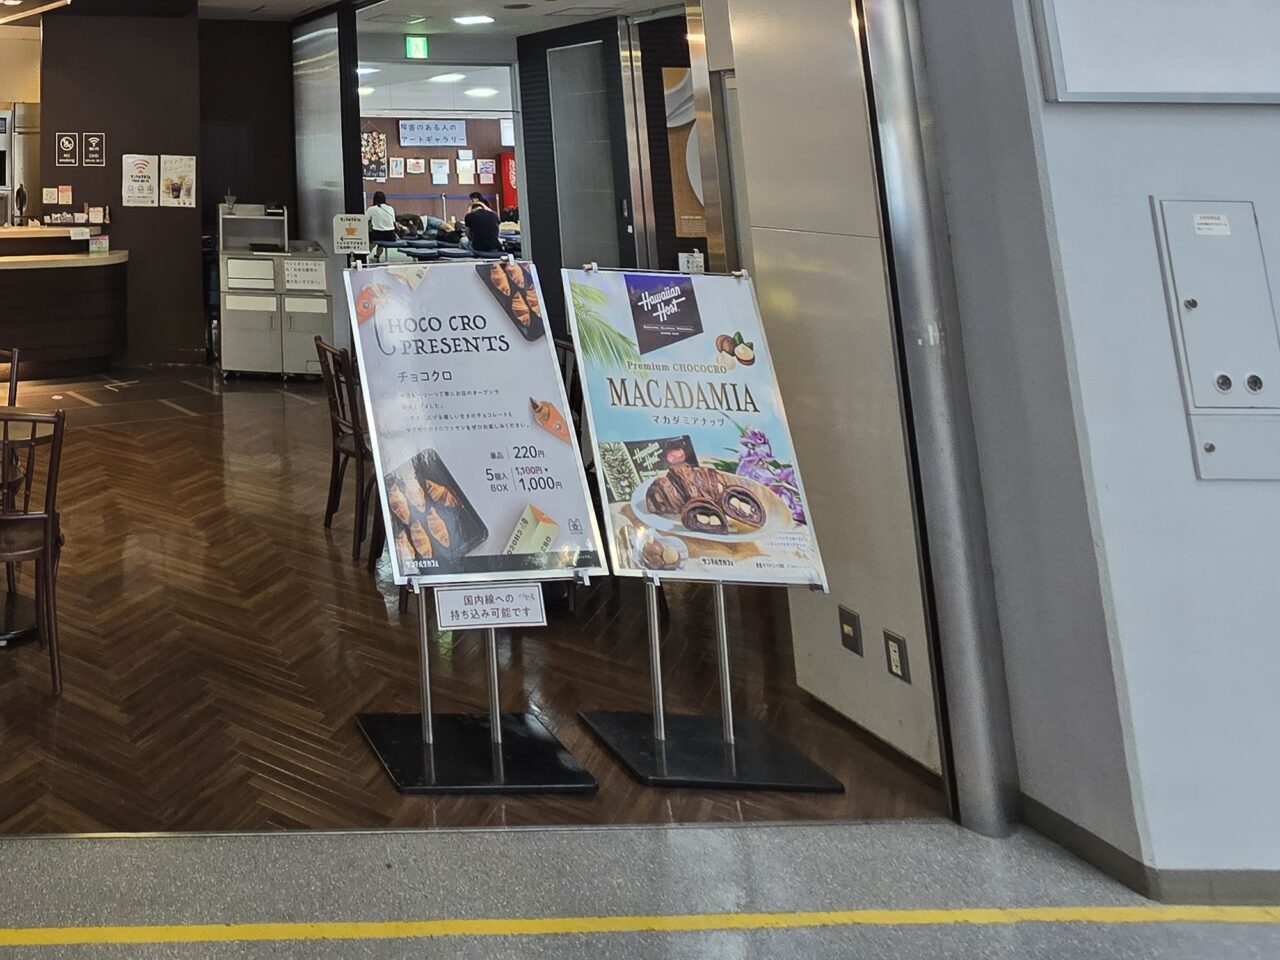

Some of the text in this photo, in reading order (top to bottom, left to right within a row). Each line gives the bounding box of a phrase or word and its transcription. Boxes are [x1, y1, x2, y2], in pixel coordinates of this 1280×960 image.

[402, 136, 465, 144] アートギャラリー
[637, 286, 681, 311] Hawaiian
[449, 314, 487, 333] CRO
[400, 334, 510, 356] PRESENTS
[627, 360, 727, 375] Premium CHOCOCRO
[397, 369, 453, 384] チョコクロ
[606, 377, 761, 414] MACADAMIA
[651, 415, 726, 428] マカダミアナッツ
[512, 445, 546, 459] 220円
[490, 476, 563, 492] BOX 1,000円
[463, 593, 514, 606] 国内線への
[450, 606, 532, 621] 持ち込み可能です
